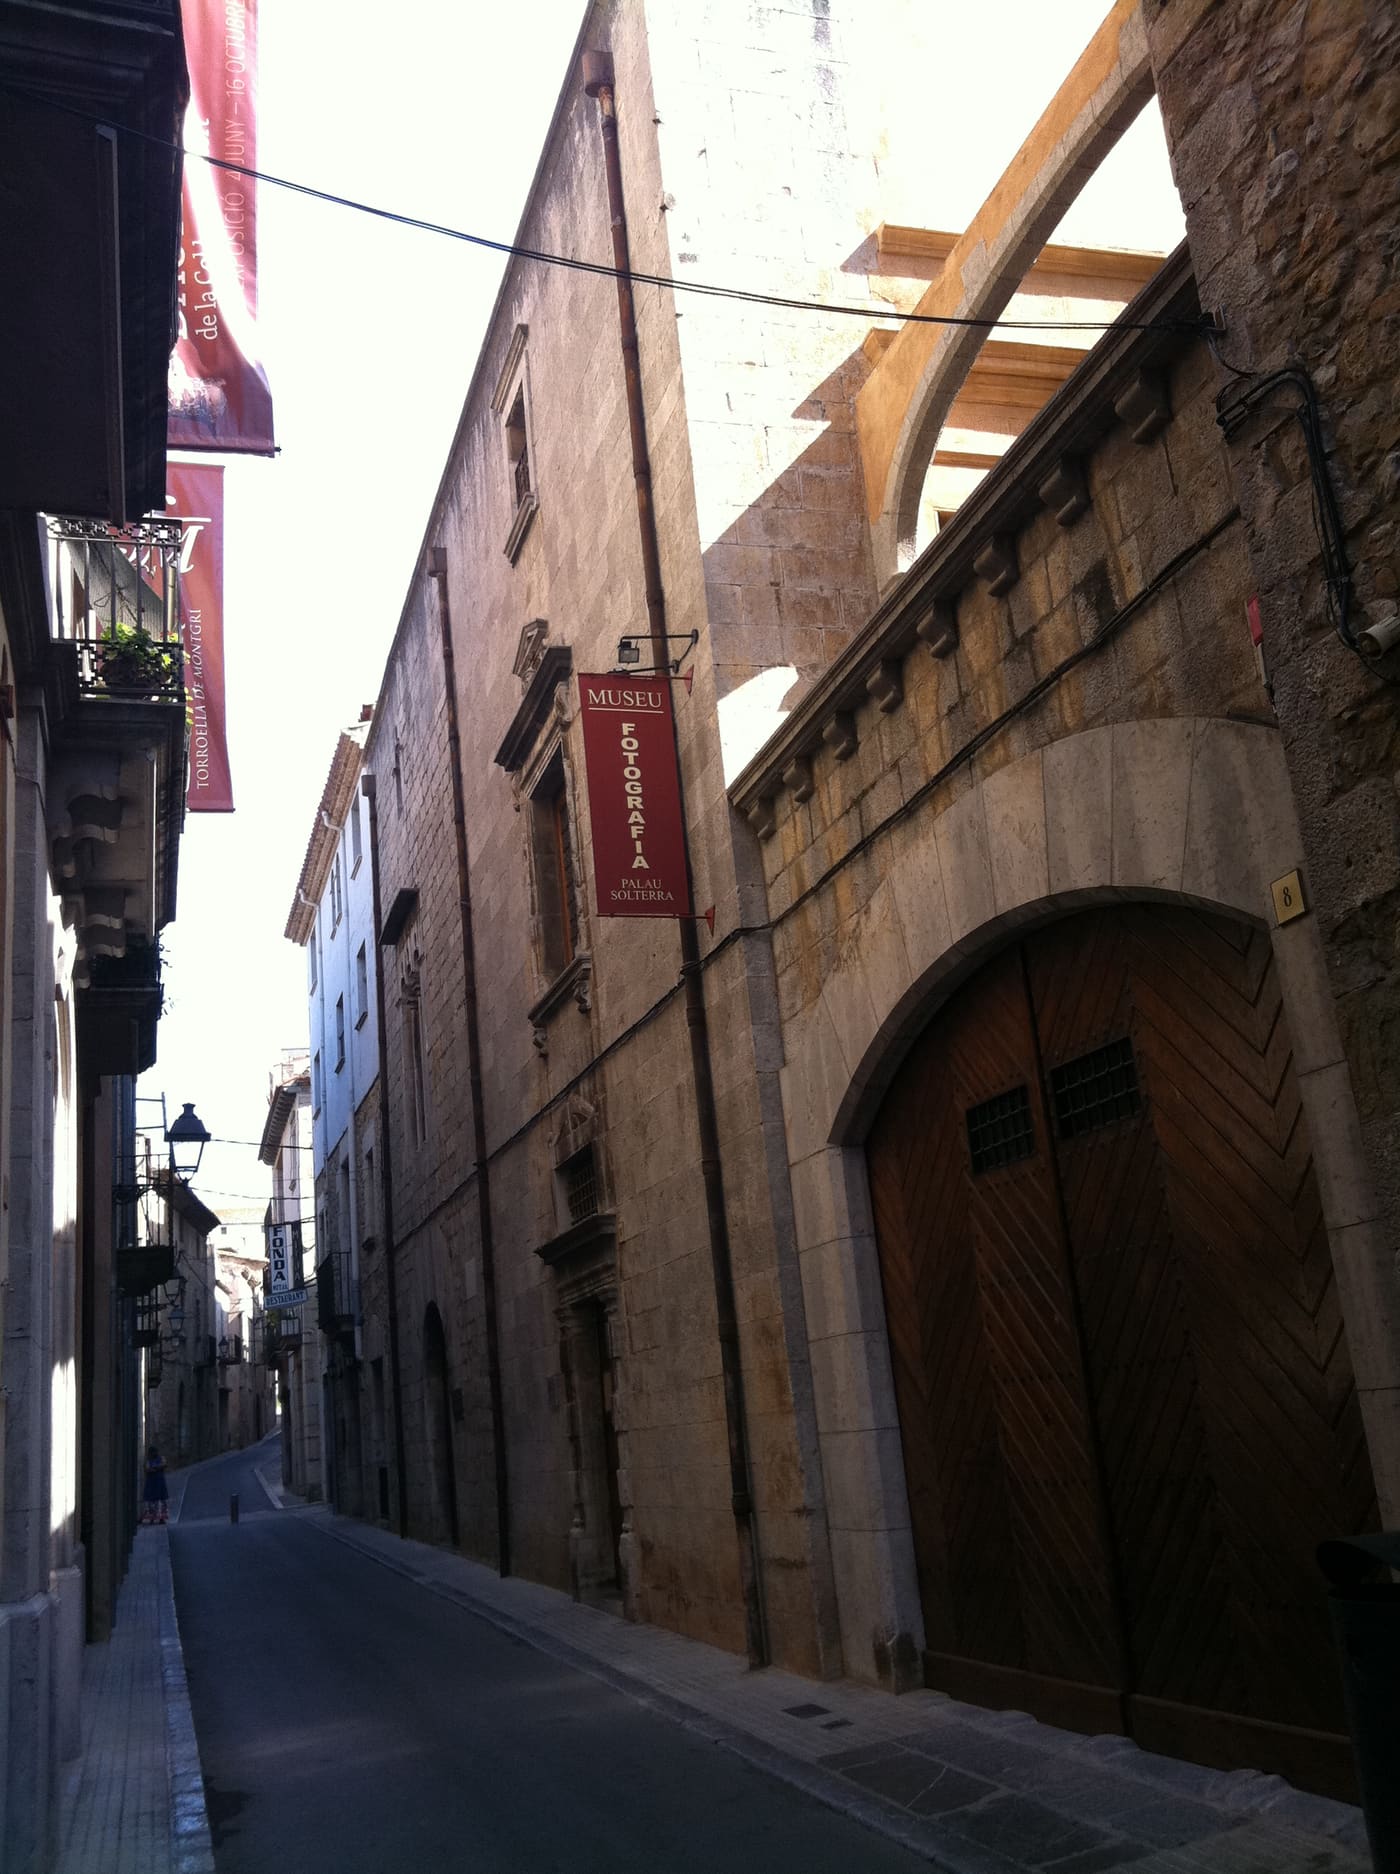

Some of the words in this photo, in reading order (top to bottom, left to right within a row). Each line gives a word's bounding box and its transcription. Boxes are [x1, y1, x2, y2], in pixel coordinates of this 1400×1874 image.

[226, 79, 246, 97] 16
[225, 119, 245, 164] JUNY
[194, 292, 217, 311] la
[196, 315, 218, 340] de
[193, 681, 206, 700] DE
[588, 689, 662, 708] MUSEU
[195, 705, 209, 789] TORROELLA
[621, 723, 649, 868] FOTOGRAFIA
[621, 879, 662, 889] PALAU
[611, 890, 674, 901] SOLTERRA
[1283, 886, 1292, 907] 8
[272, 1225, 285, 1281] FONDA
